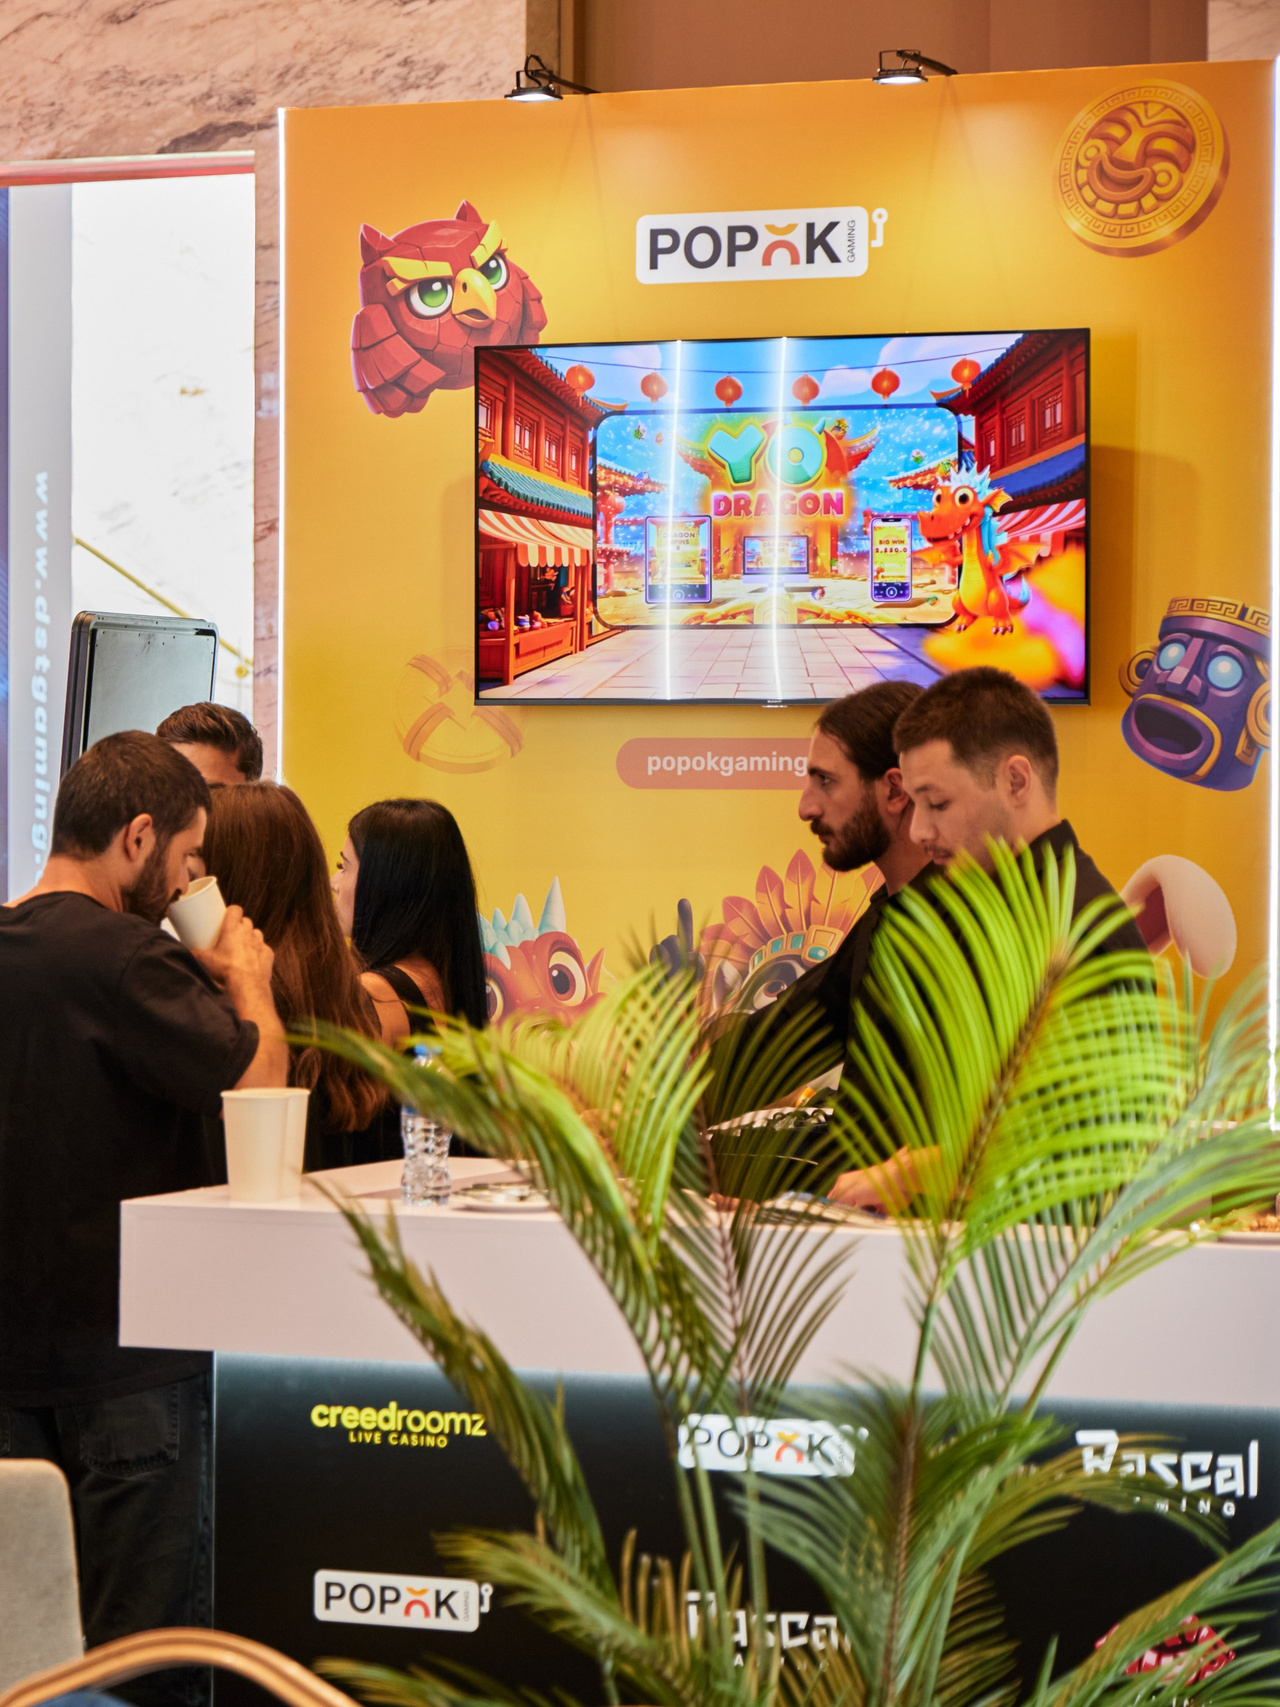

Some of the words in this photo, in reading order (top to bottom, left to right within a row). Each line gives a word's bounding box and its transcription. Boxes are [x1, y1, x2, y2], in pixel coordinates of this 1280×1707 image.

[847, 220, 856, 263] GAMING
[708, 423, 825, 486] YO
[713, 492, 844, 517] DRAGON
[647, 751, 808, 777] popokgaming
[310, 1401, 487, 1437] creedroomz
[349, 1431, 382, 1444] LIVE
[388, 1433, 448, 1449] CASINO
